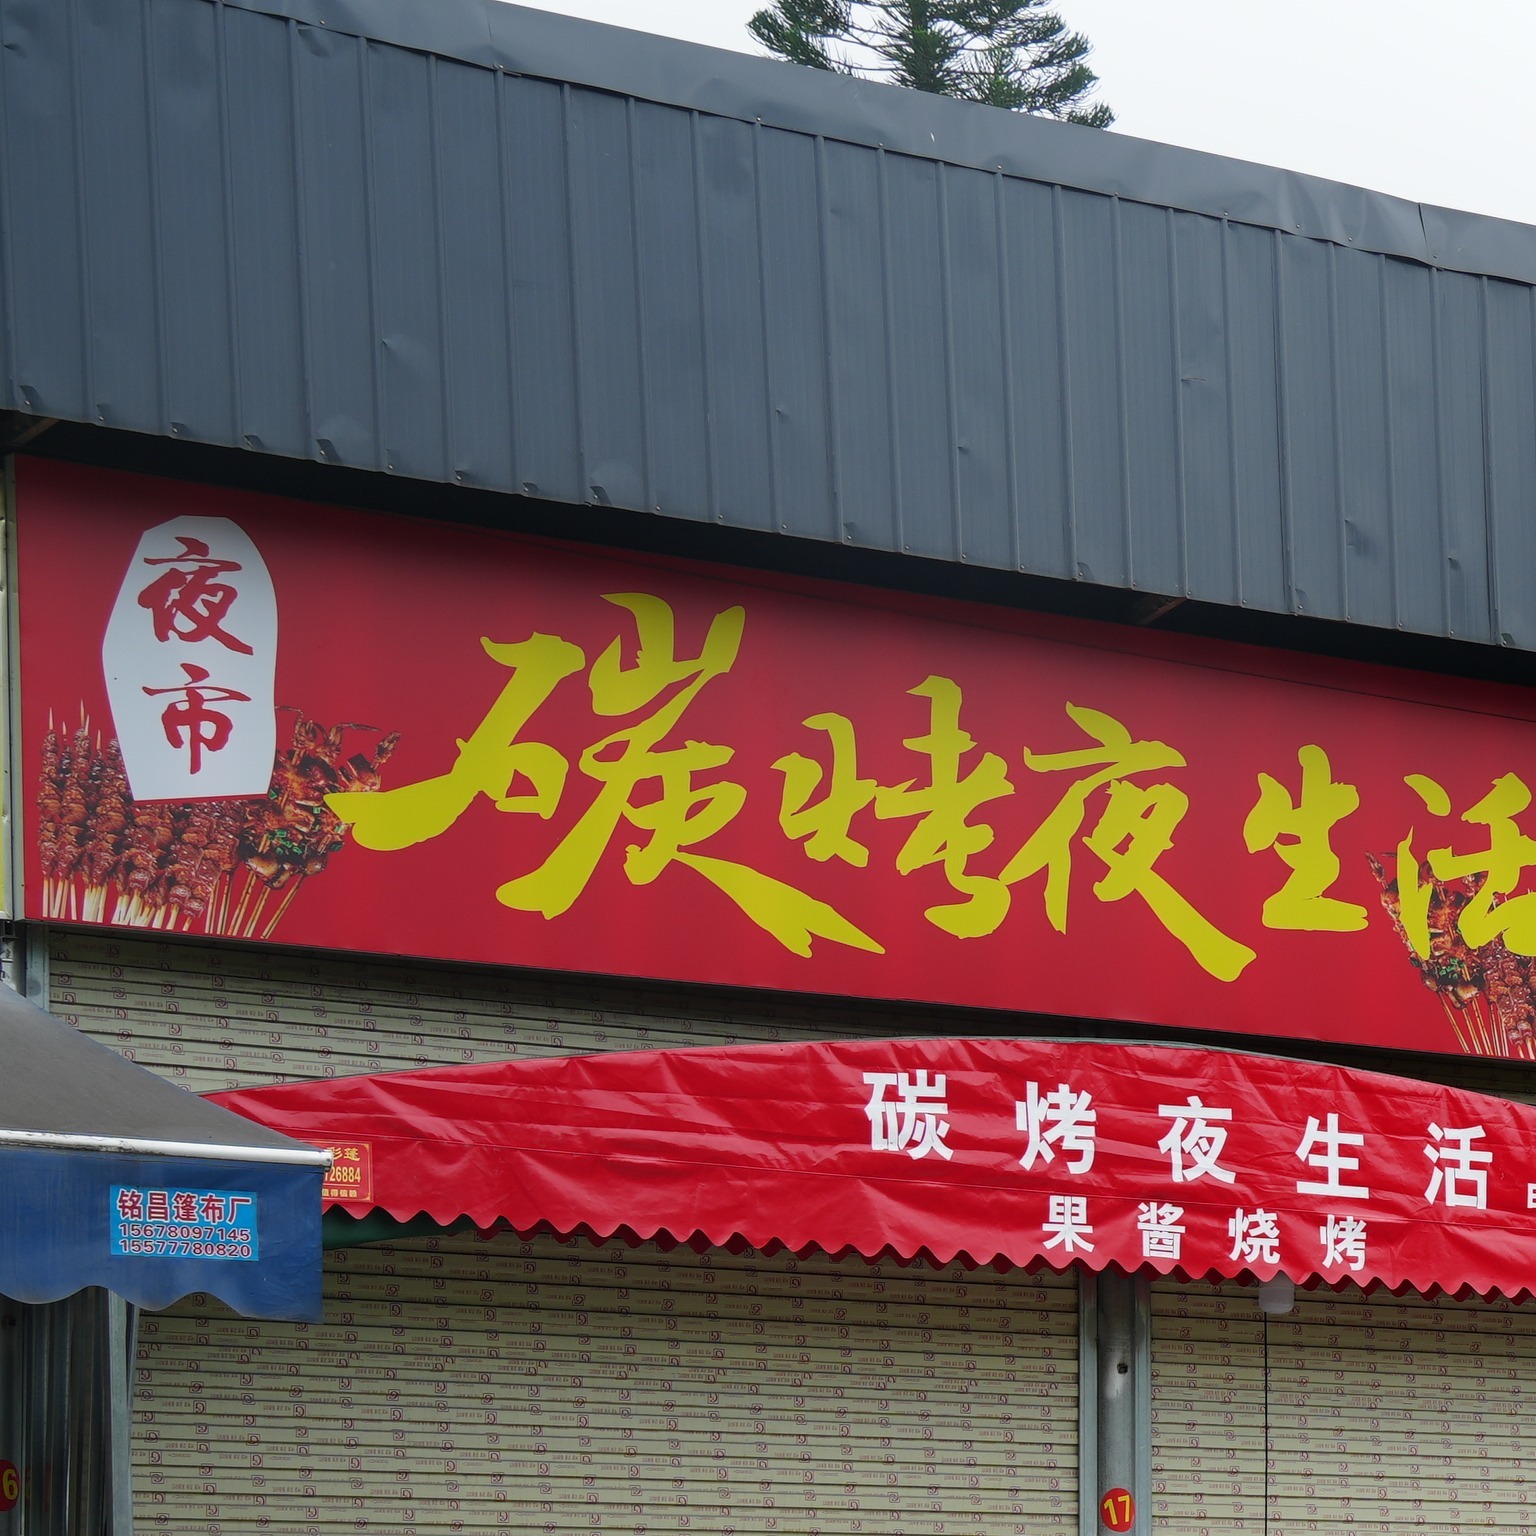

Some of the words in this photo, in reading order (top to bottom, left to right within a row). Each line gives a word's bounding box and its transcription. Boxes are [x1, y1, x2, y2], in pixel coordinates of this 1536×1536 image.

[138, 536, 254, 775] 夜市
[862, 1069, 1495, 1210] 碳烤夜生活
[117, 1188, 252, 1225] 铭昌篷布厂
[118, 1222, 251, 1243] 15678097145
[119, 1238, 252, 1258] 15577780820
[1042, 1195, 1368, 1272] 果酱烧烤
[1103, 1494, 1130, 1526] 17
